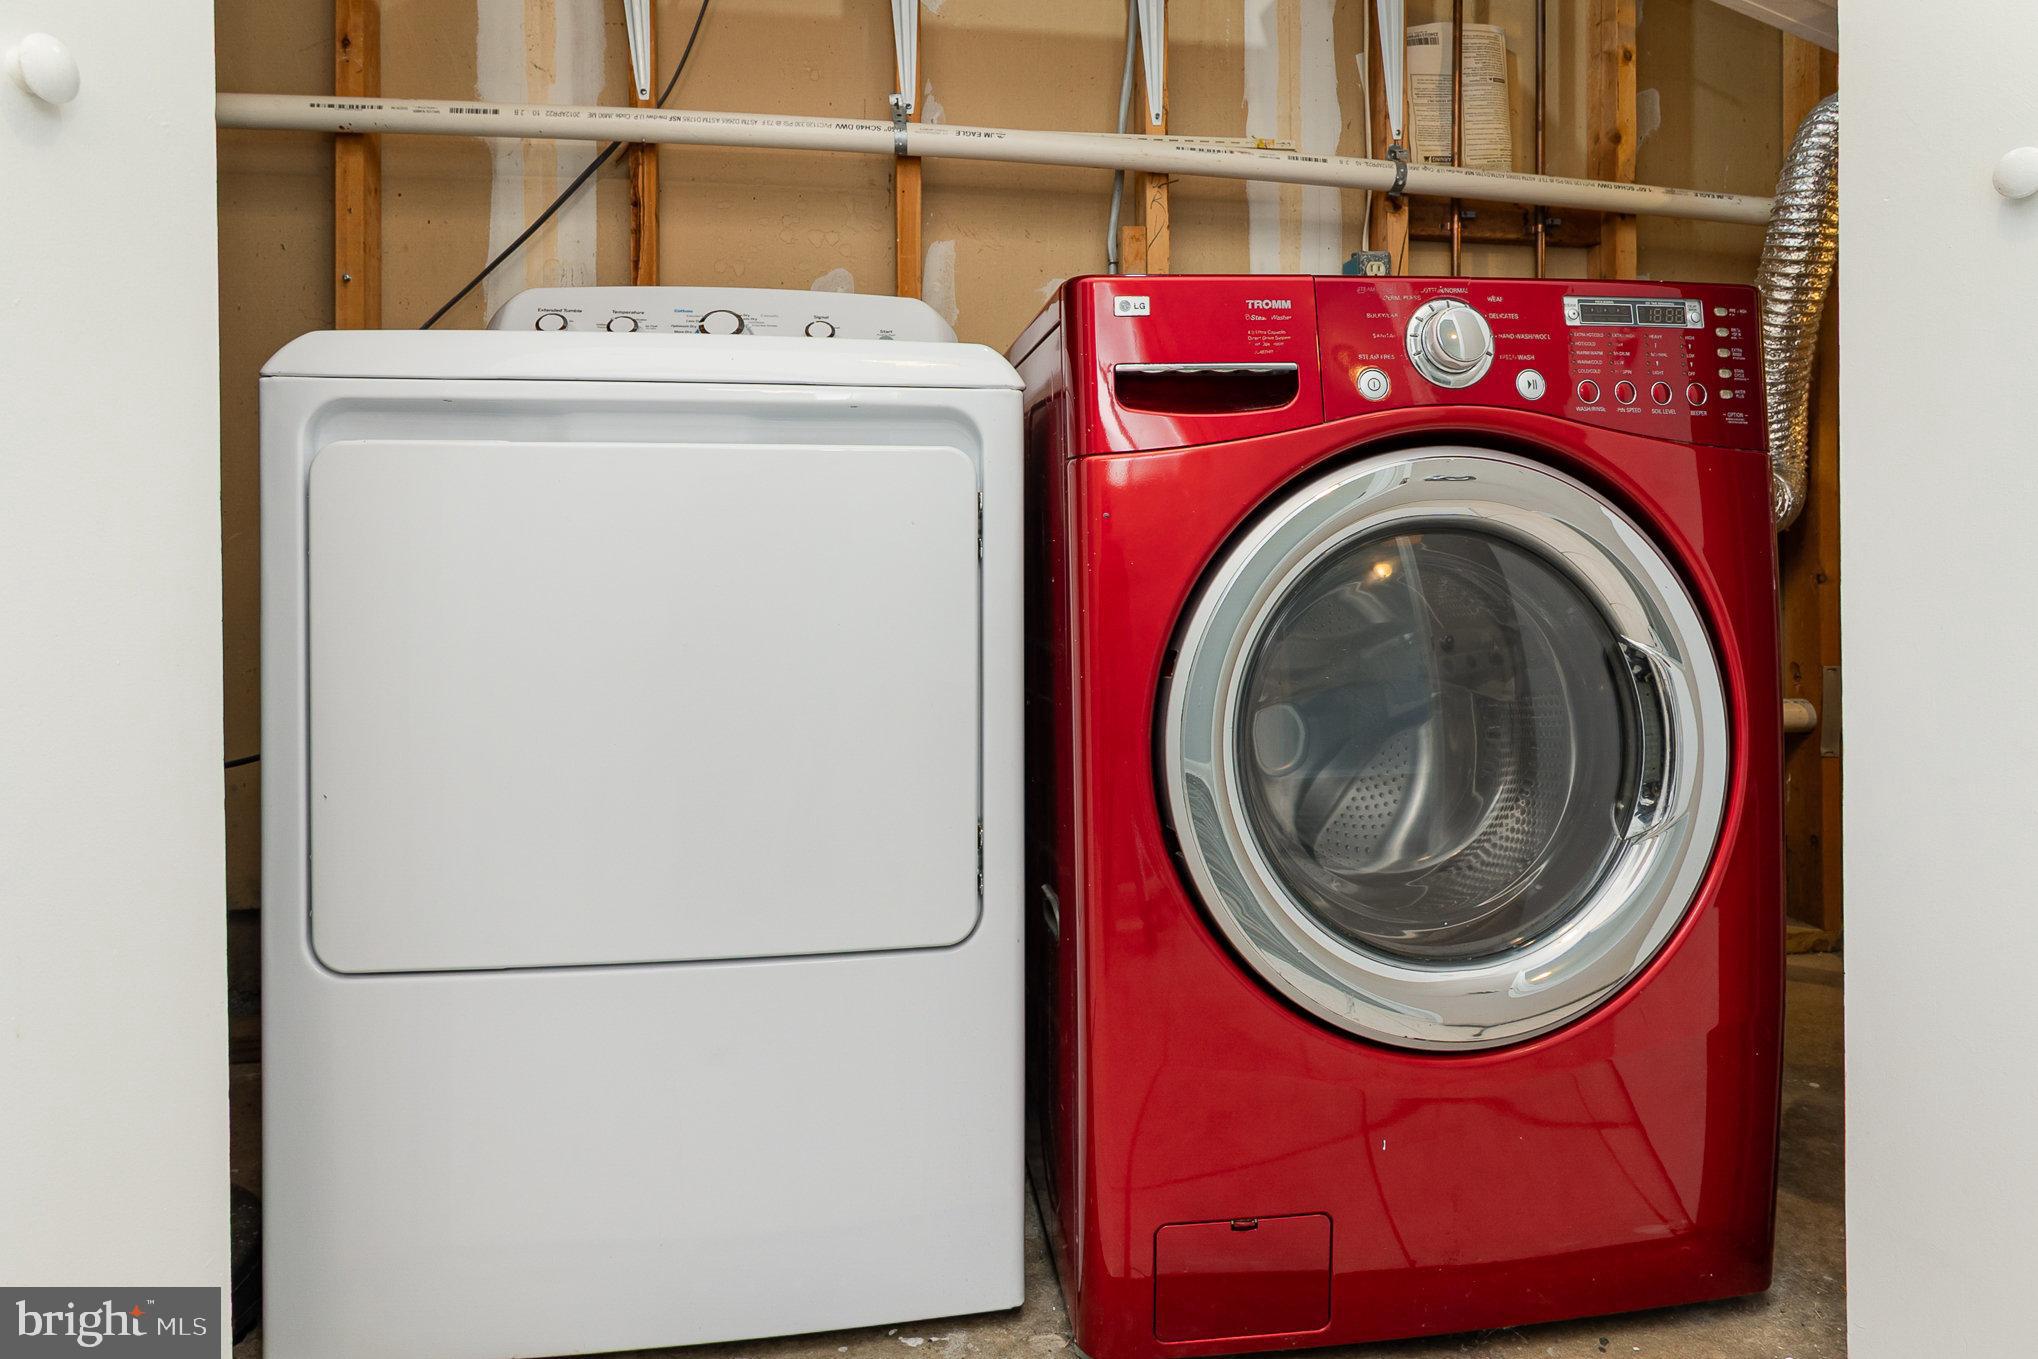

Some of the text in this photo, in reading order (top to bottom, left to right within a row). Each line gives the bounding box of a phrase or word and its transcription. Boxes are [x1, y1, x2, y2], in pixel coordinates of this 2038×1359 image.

[955, 130, 982, 138] EAGLE
[1133, 302, 1146, 310] LG
[1246, 299, 1292, 309] TROMM
